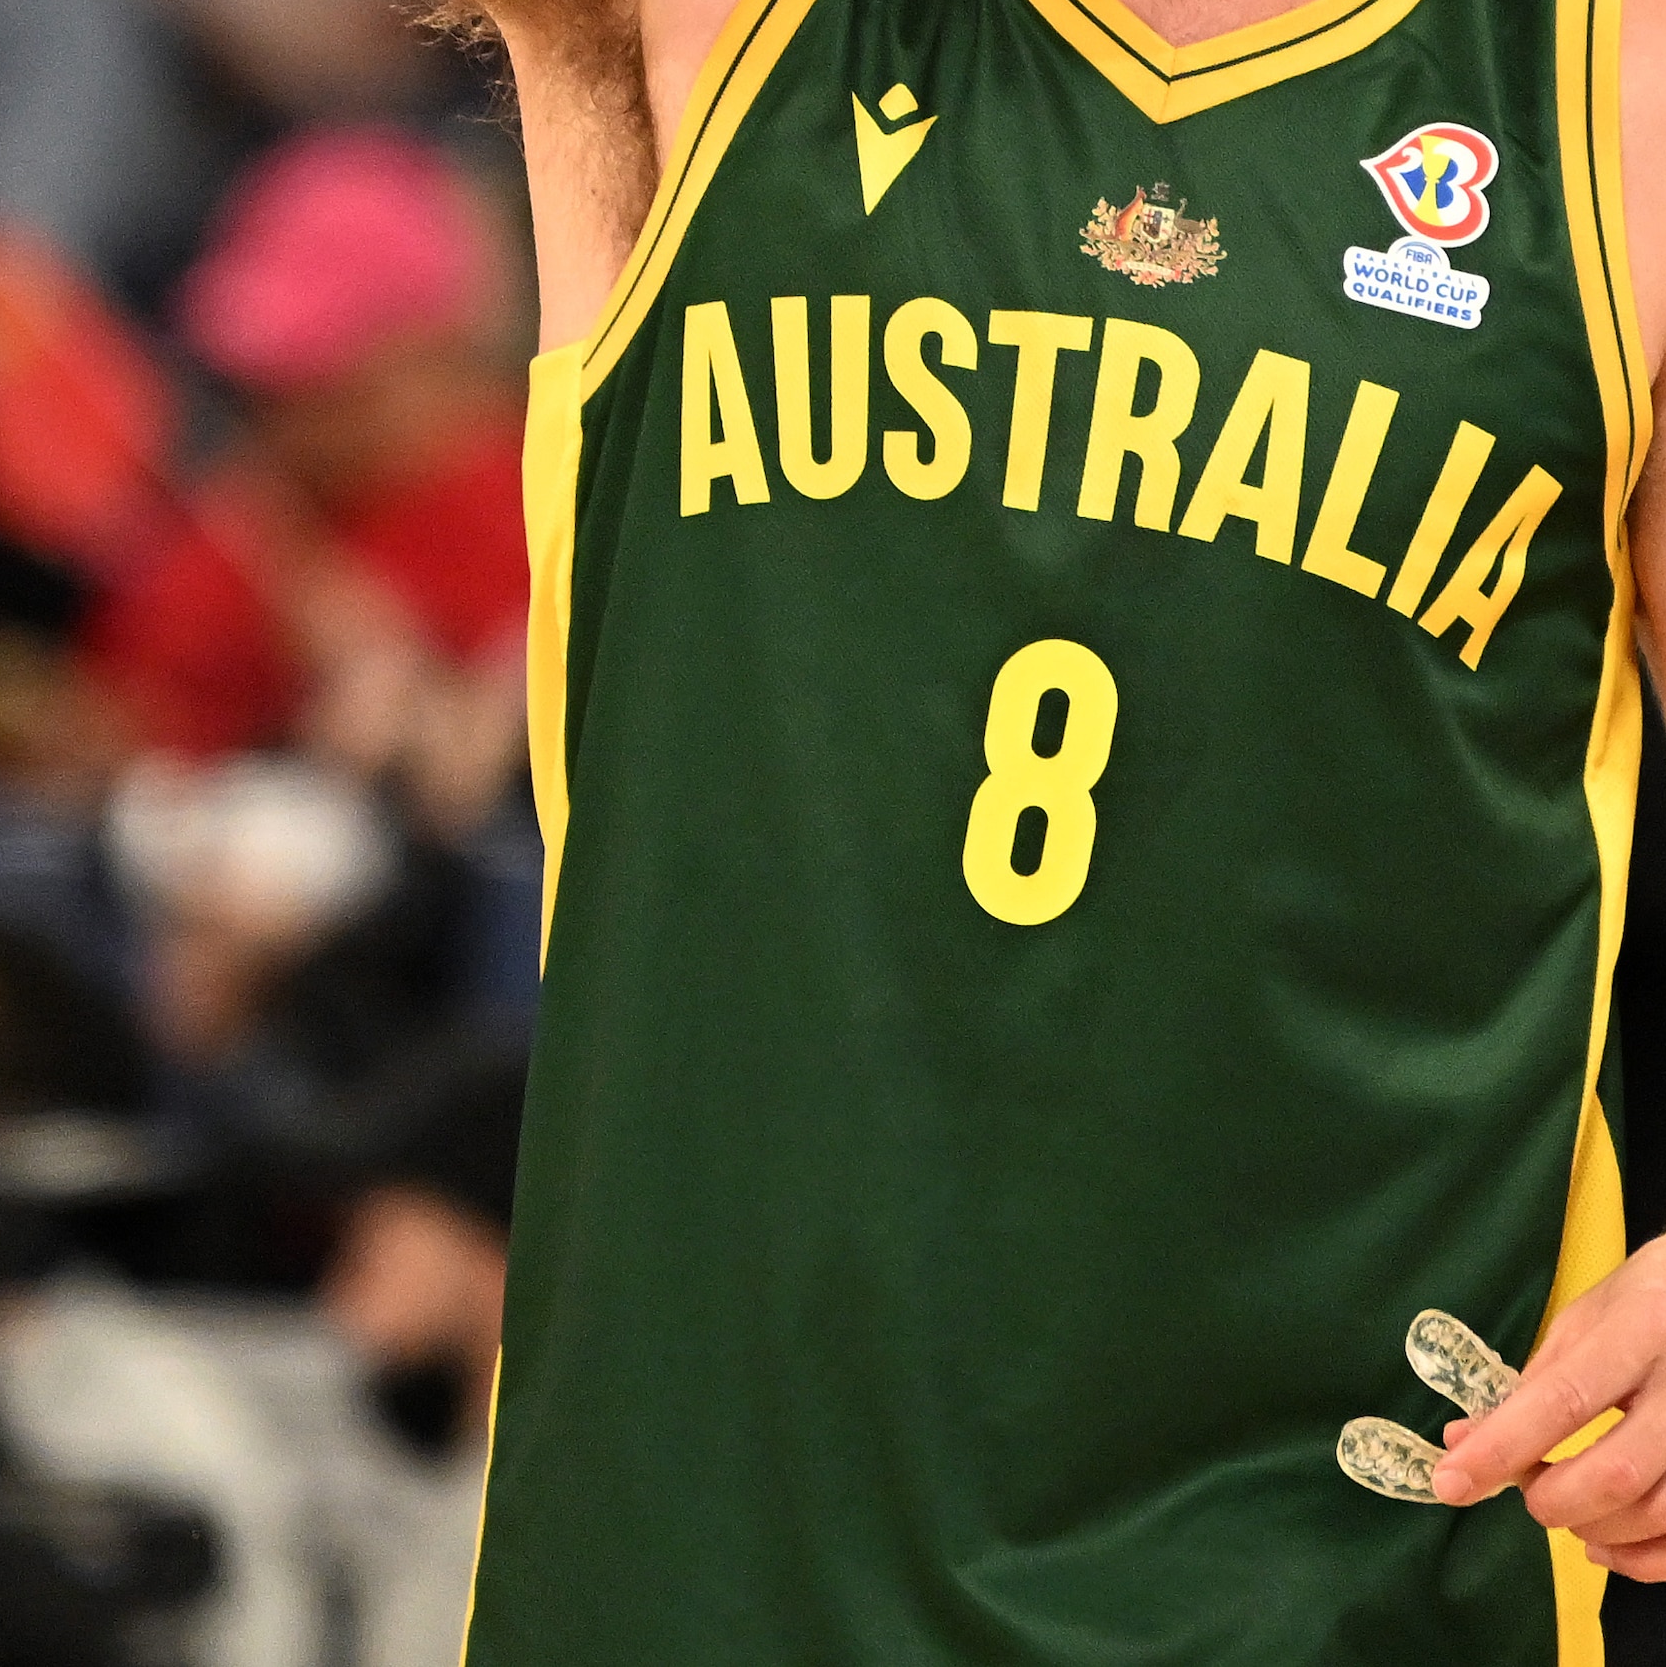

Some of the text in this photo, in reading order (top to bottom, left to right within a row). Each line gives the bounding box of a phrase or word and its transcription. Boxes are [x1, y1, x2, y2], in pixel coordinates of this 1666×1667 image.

[1405, 248, 1432, 265] FIBA
[1352, 282, 1472, 322] QUALIFIERS
[1353, 262, 1478, 304] WORLD CUP
[679, 294, 1564, 672] AUSTRALIA
[962, 638, 1119, 926] 8
